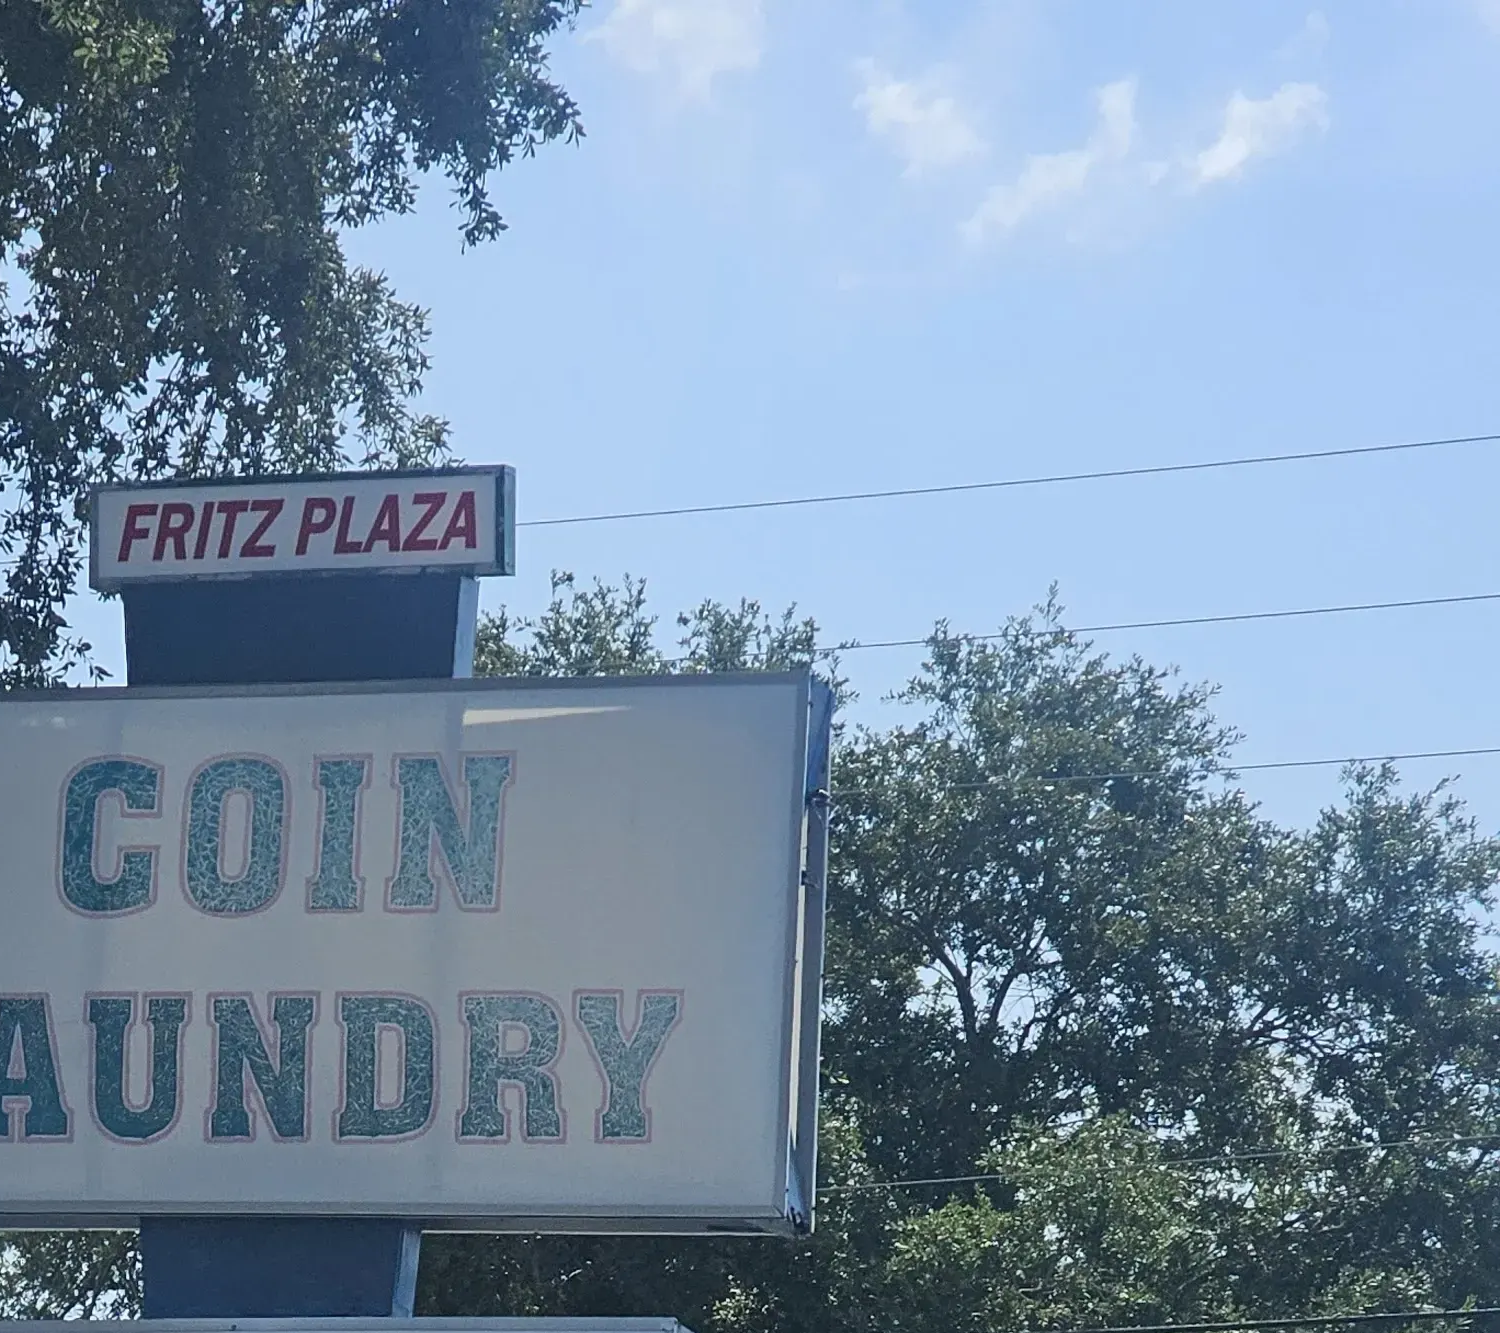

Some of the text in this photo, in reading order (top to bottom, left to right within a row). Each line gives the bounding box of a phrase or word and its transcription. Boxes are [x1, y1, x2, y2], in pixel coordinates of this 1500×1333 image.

[117, 491, 477, 563] FRITZ PLAZA
[55, 750, 516, 918] COIN
